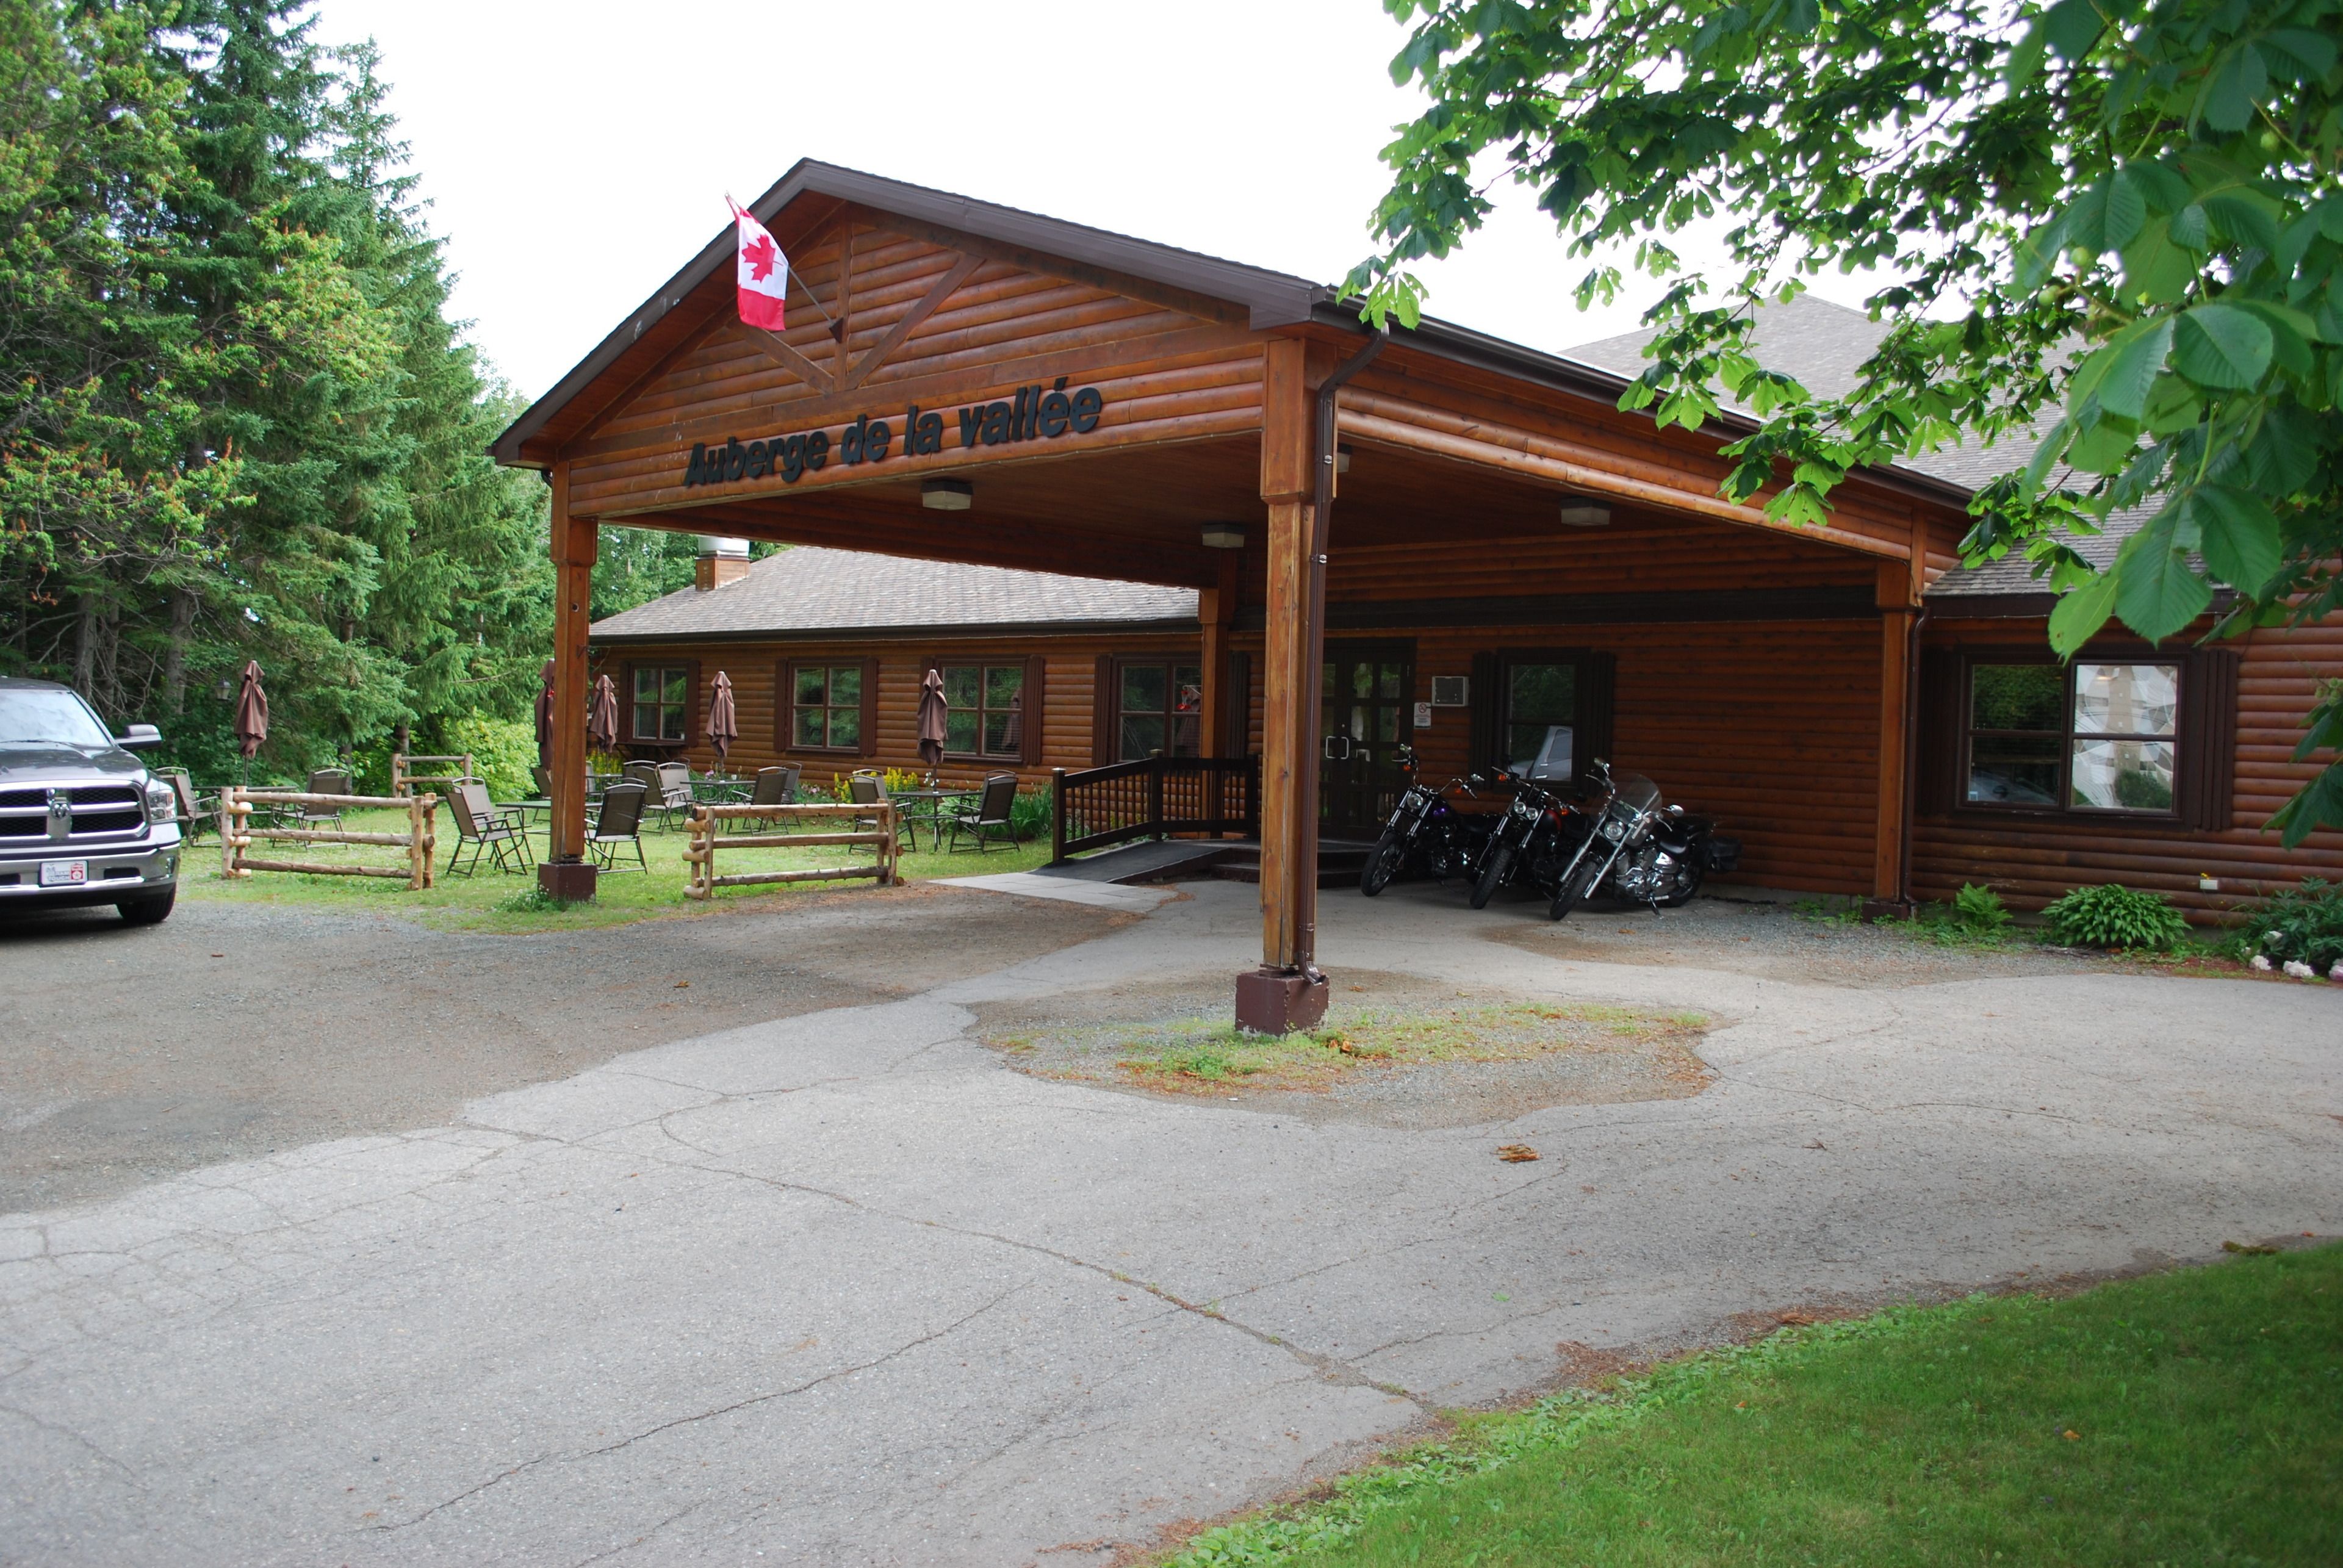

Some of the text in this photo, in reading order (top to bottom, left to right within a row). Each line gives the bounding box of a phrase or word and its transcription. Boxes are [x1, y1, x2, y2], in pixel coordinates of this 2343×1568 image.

[684, 376, 1103, 487] Auberge de la vallée
